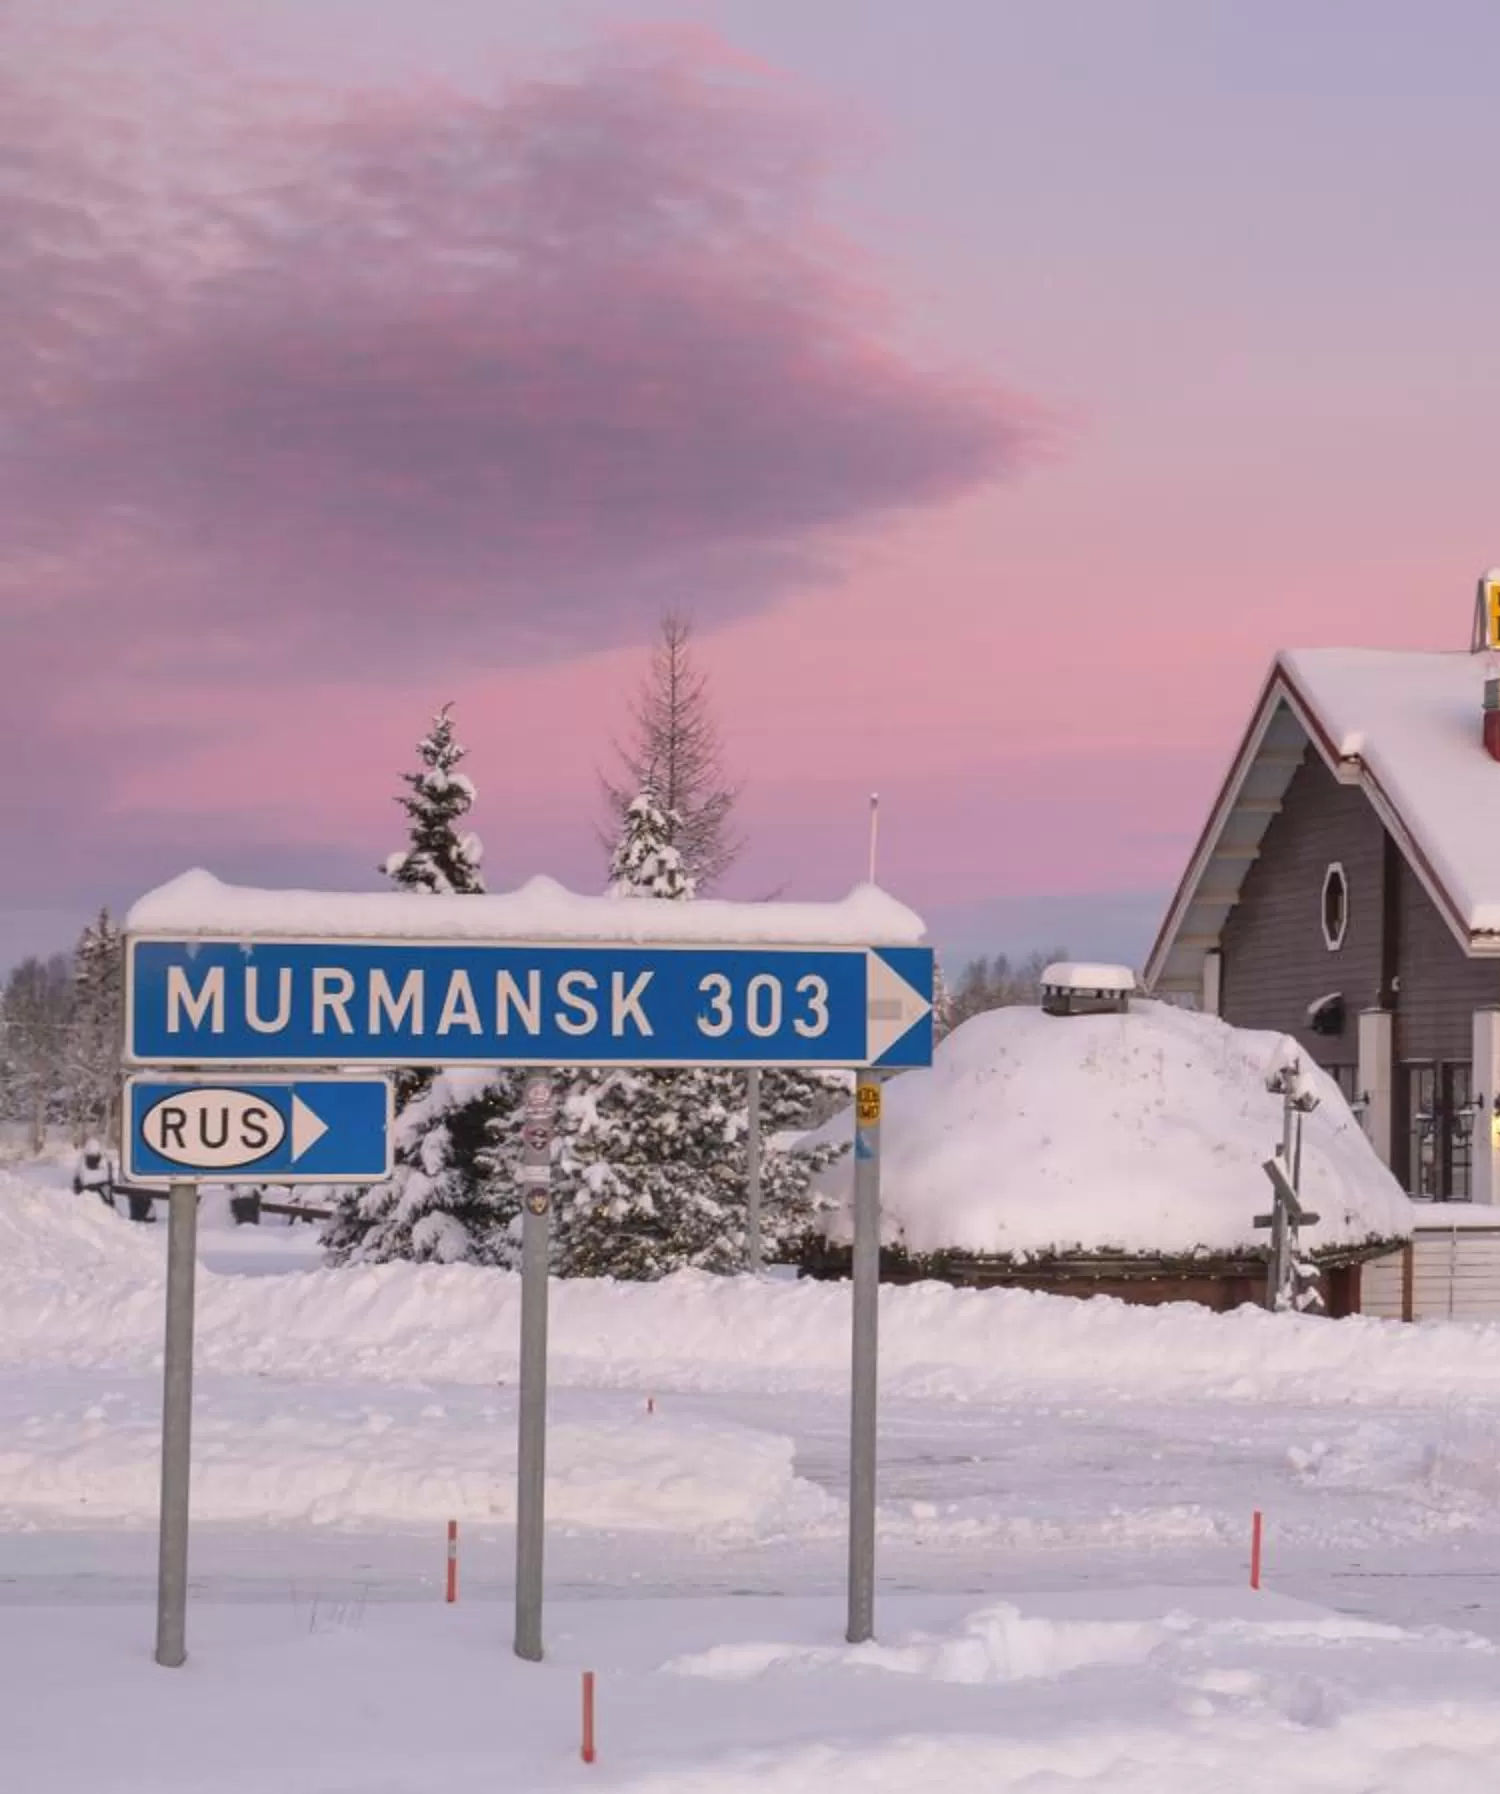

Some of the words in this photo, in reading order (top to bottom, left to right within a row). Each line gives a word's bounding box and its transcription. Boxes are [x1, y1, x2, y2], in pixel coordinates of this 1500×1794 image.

[166, 965, 655, 1038] MURMANSK
[697, 973, 830, 1038] 303
[160, 1107, 269, 1150] RUS
